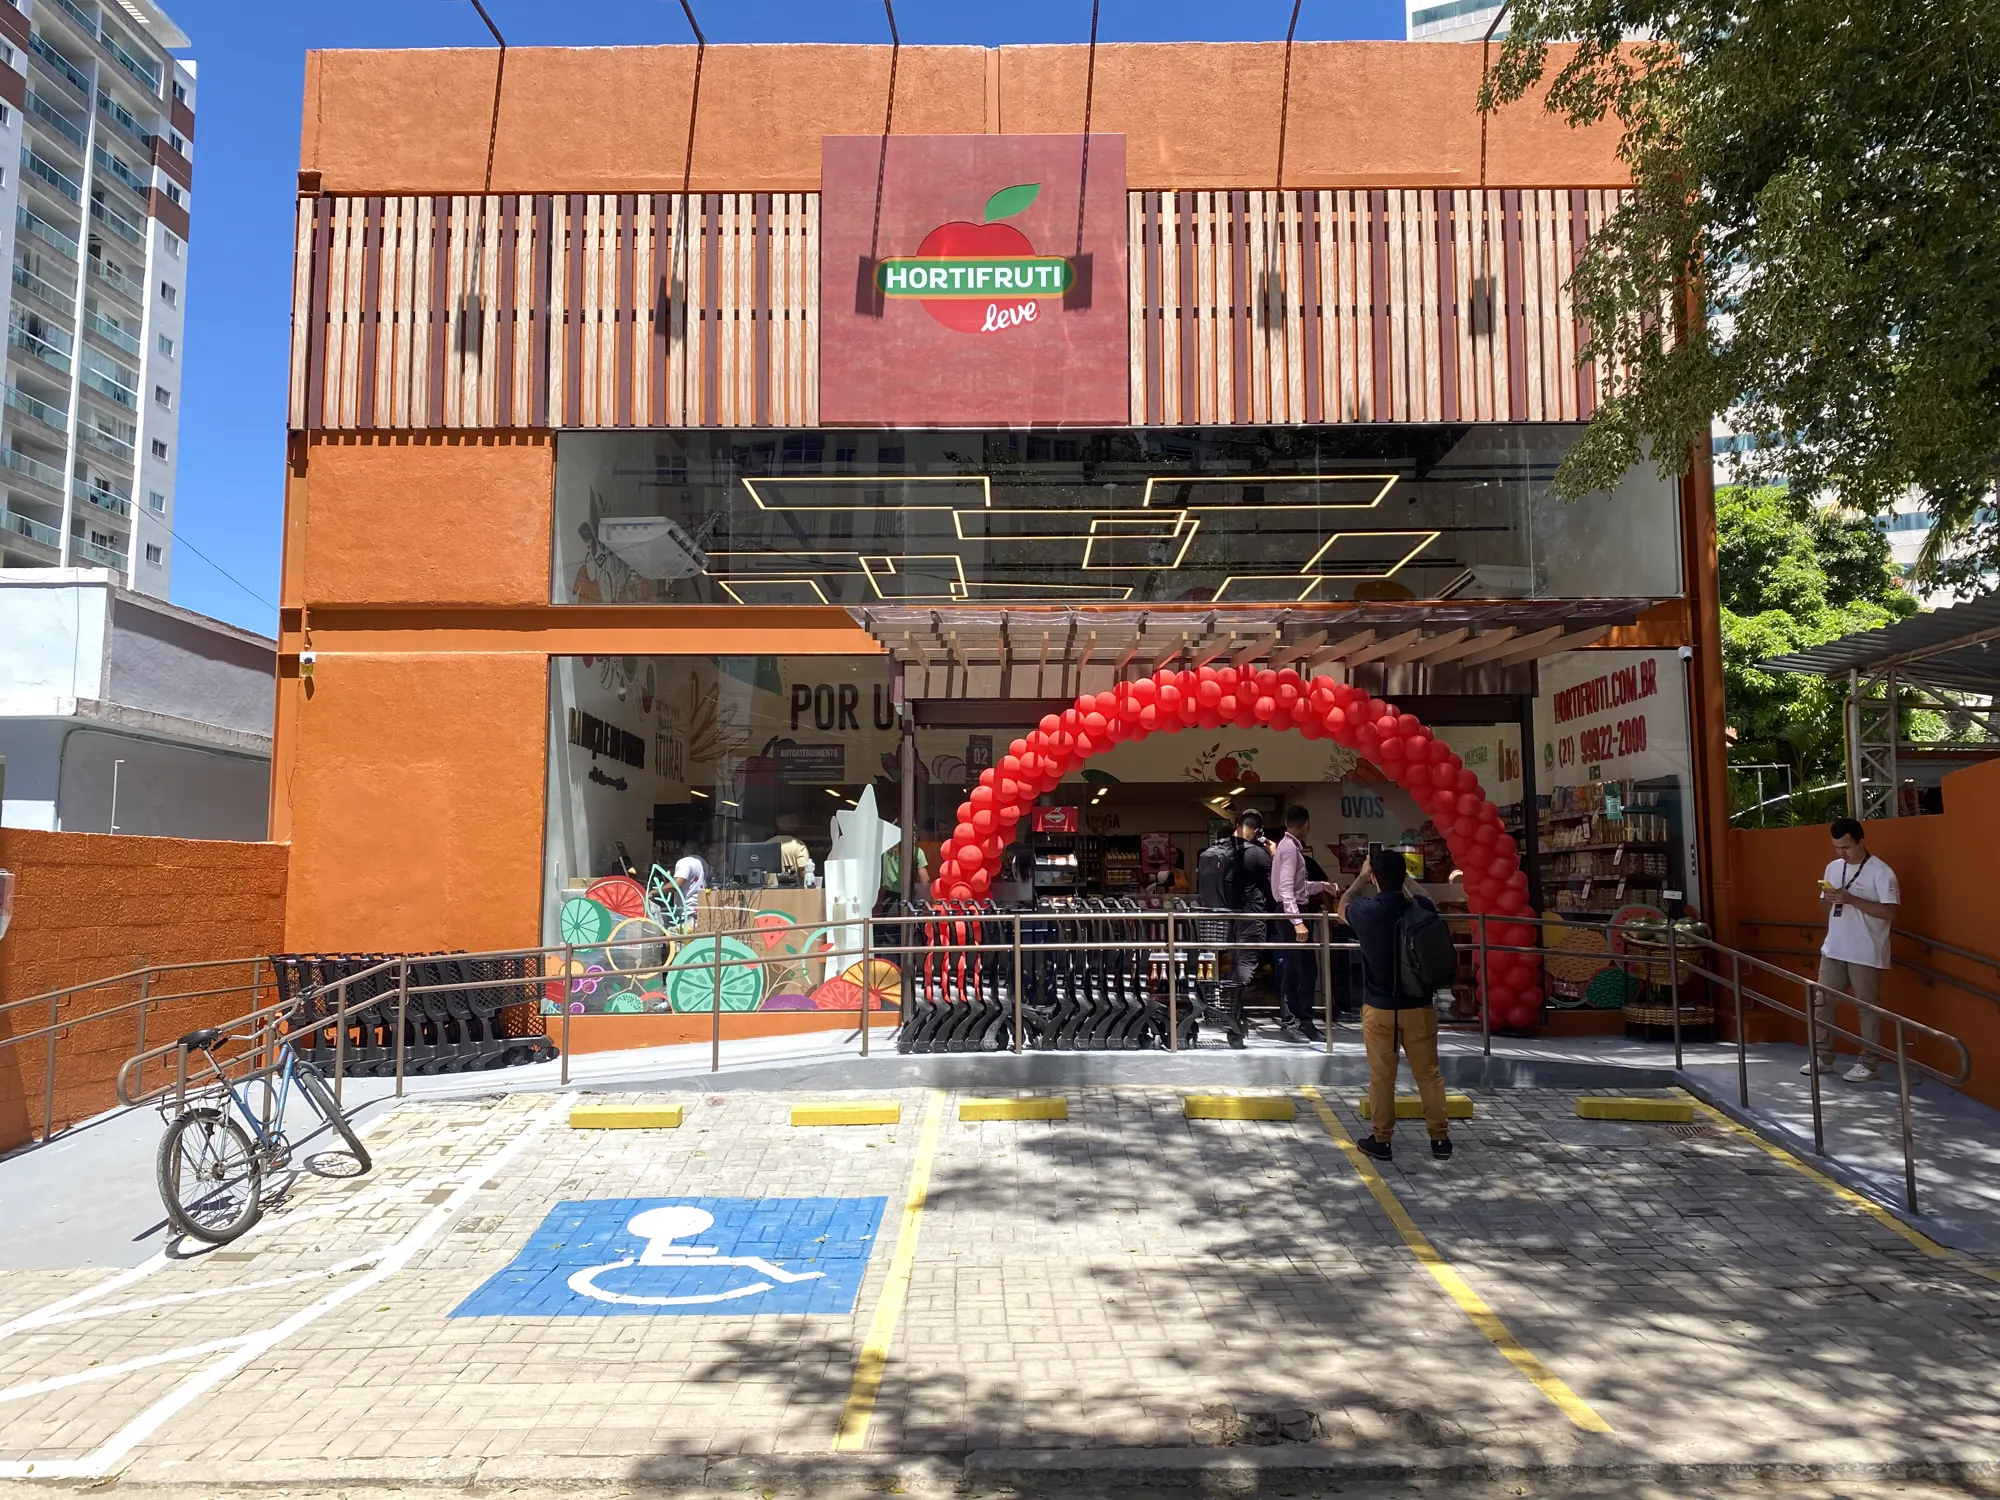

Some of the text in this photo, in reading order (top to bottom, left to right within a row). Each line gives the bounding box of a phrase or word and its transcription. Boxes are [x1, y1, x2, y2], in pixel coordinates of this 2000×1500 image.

[886, 266, 1061, 289] HORTIFRUTI
[981, 301, 1038, 332] leve
[1554, 658, 1657, 724] HORTIFRUTI.COM.BR
[791, 684, 903, 730] POR U
[780, 749, 838, 758] AUTOATENDIMENTO
[1559, 715, 1647, 768] (21) 99922-2000
[973, 747, 989, 765] 02
[1342, 796, 1384, 818] OVOS
